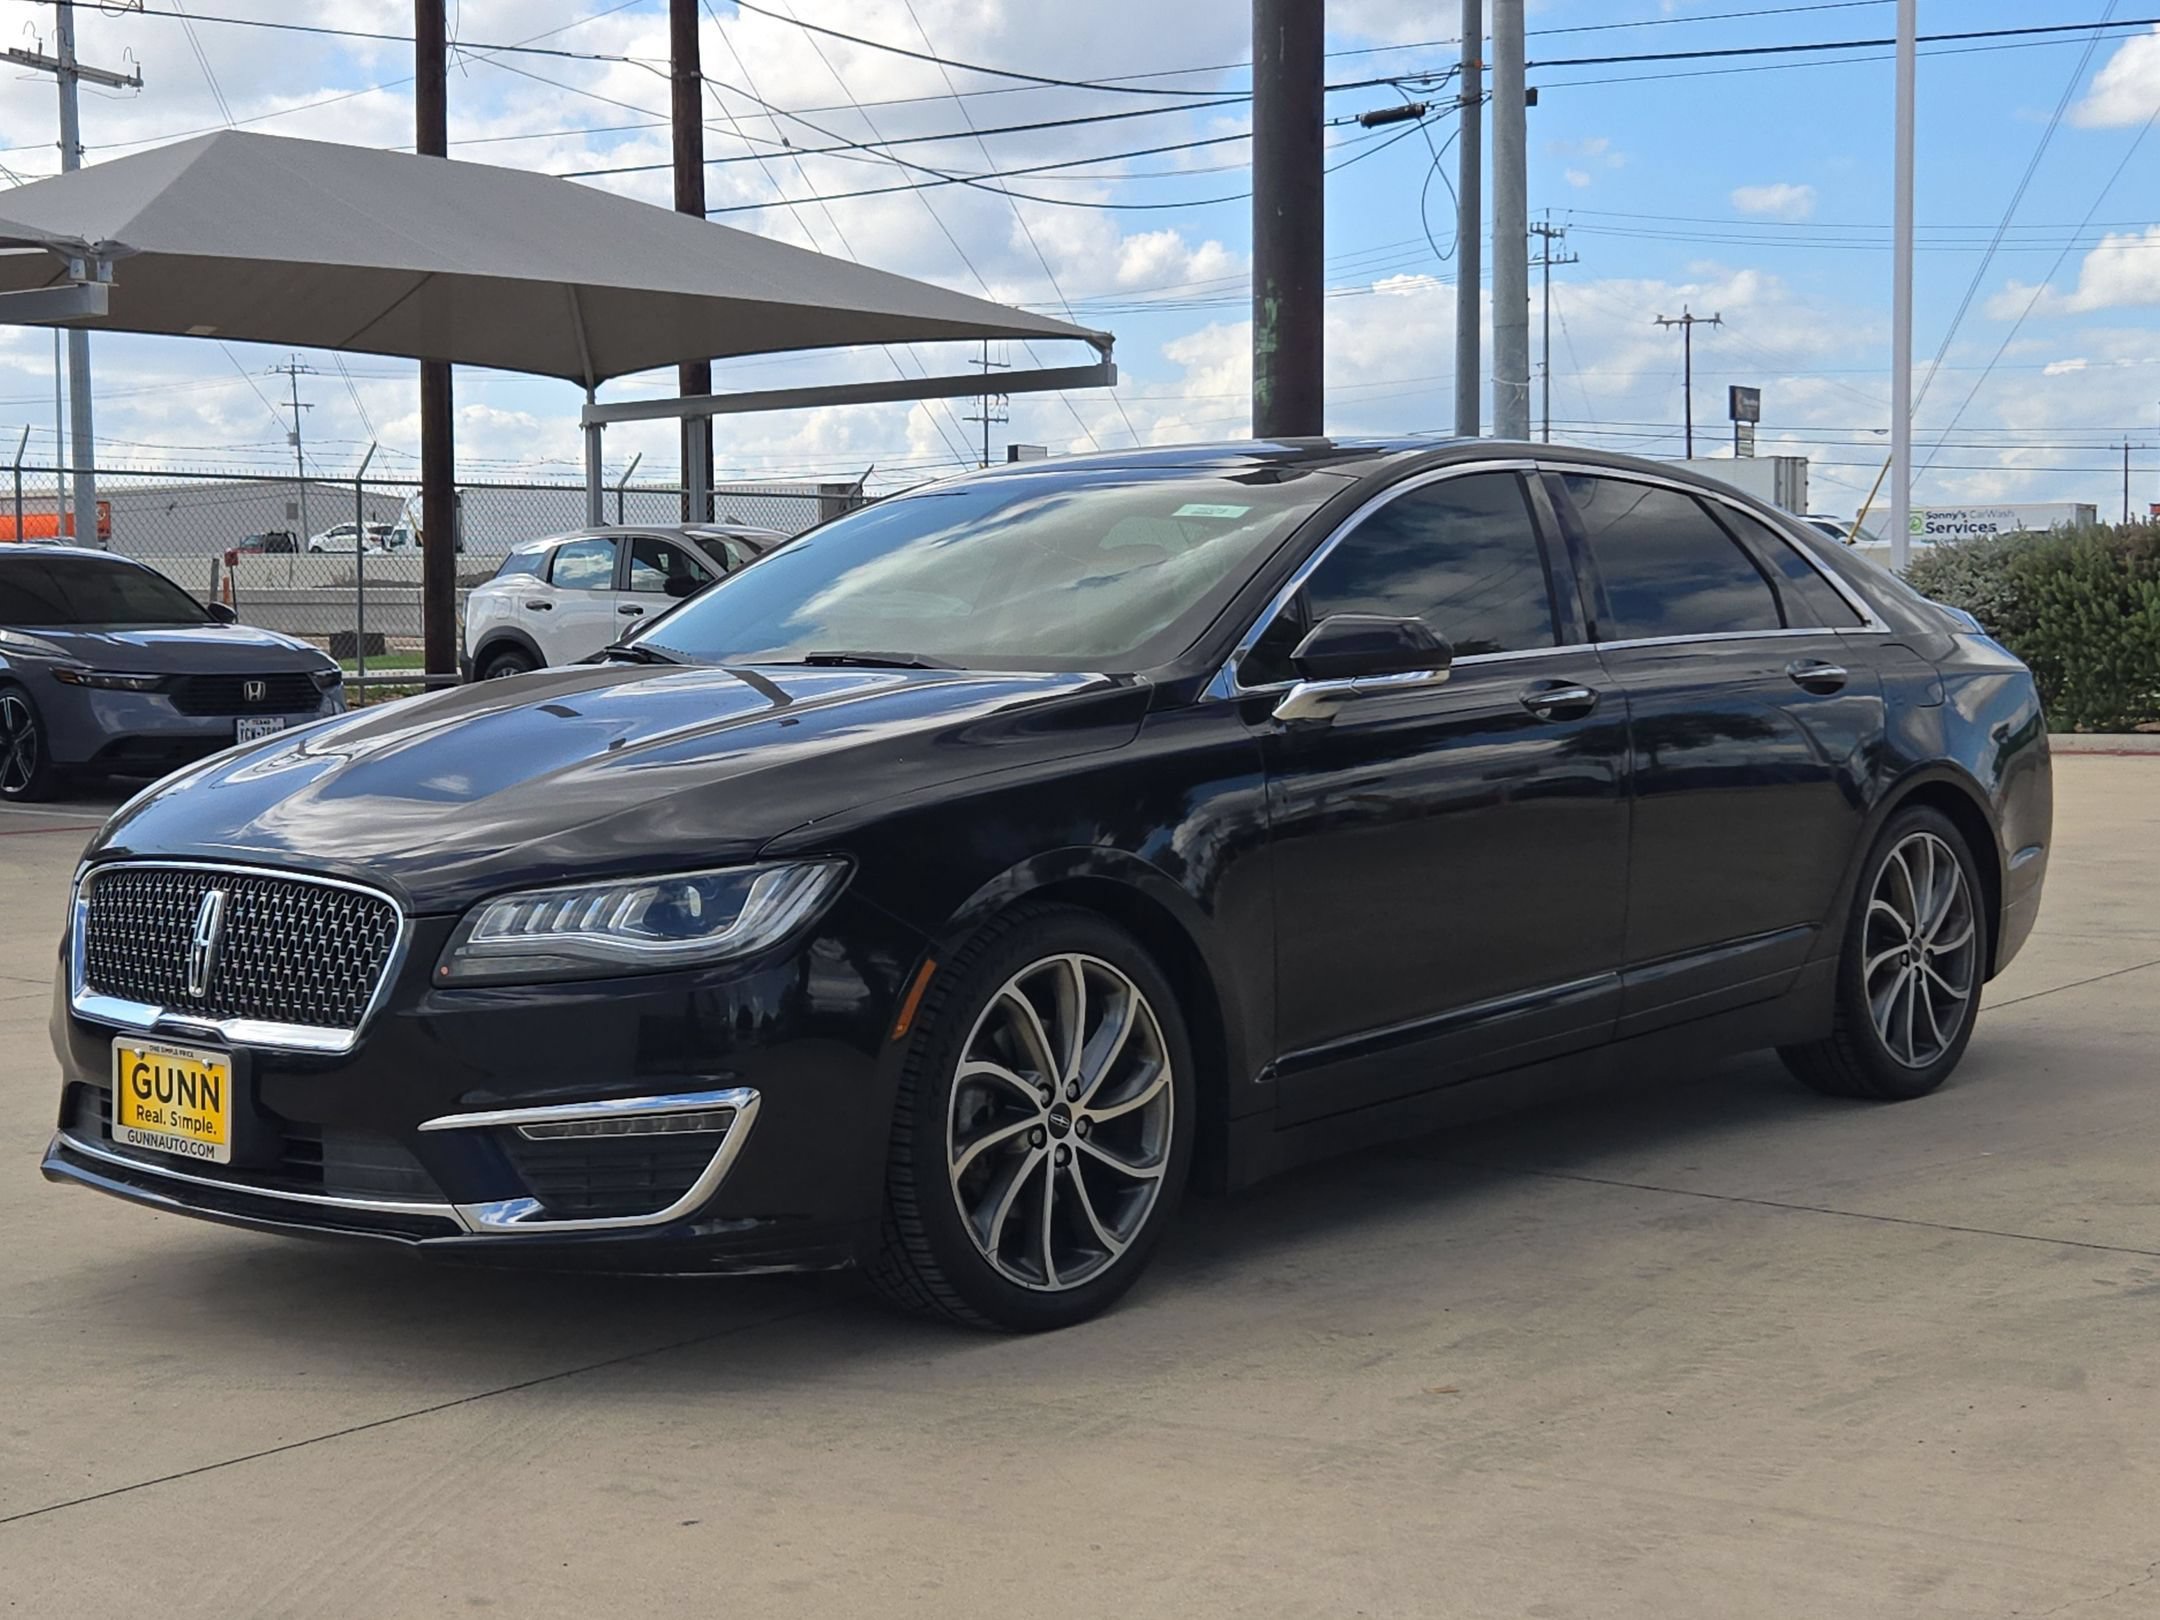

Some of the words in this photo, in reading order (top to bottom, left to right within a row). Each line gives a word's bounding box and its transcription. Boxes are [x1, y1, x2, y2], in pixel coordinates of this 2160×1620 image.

[1925, 510, 1967, 520] Sonny's
[1925, 520, 1997, 534] Services
[132, 1062, 219, 1113] GUNN
[136, 1104, 166, 1125] Real.
[127, 1129, 215, 1159] GUNNAUTO.COM
